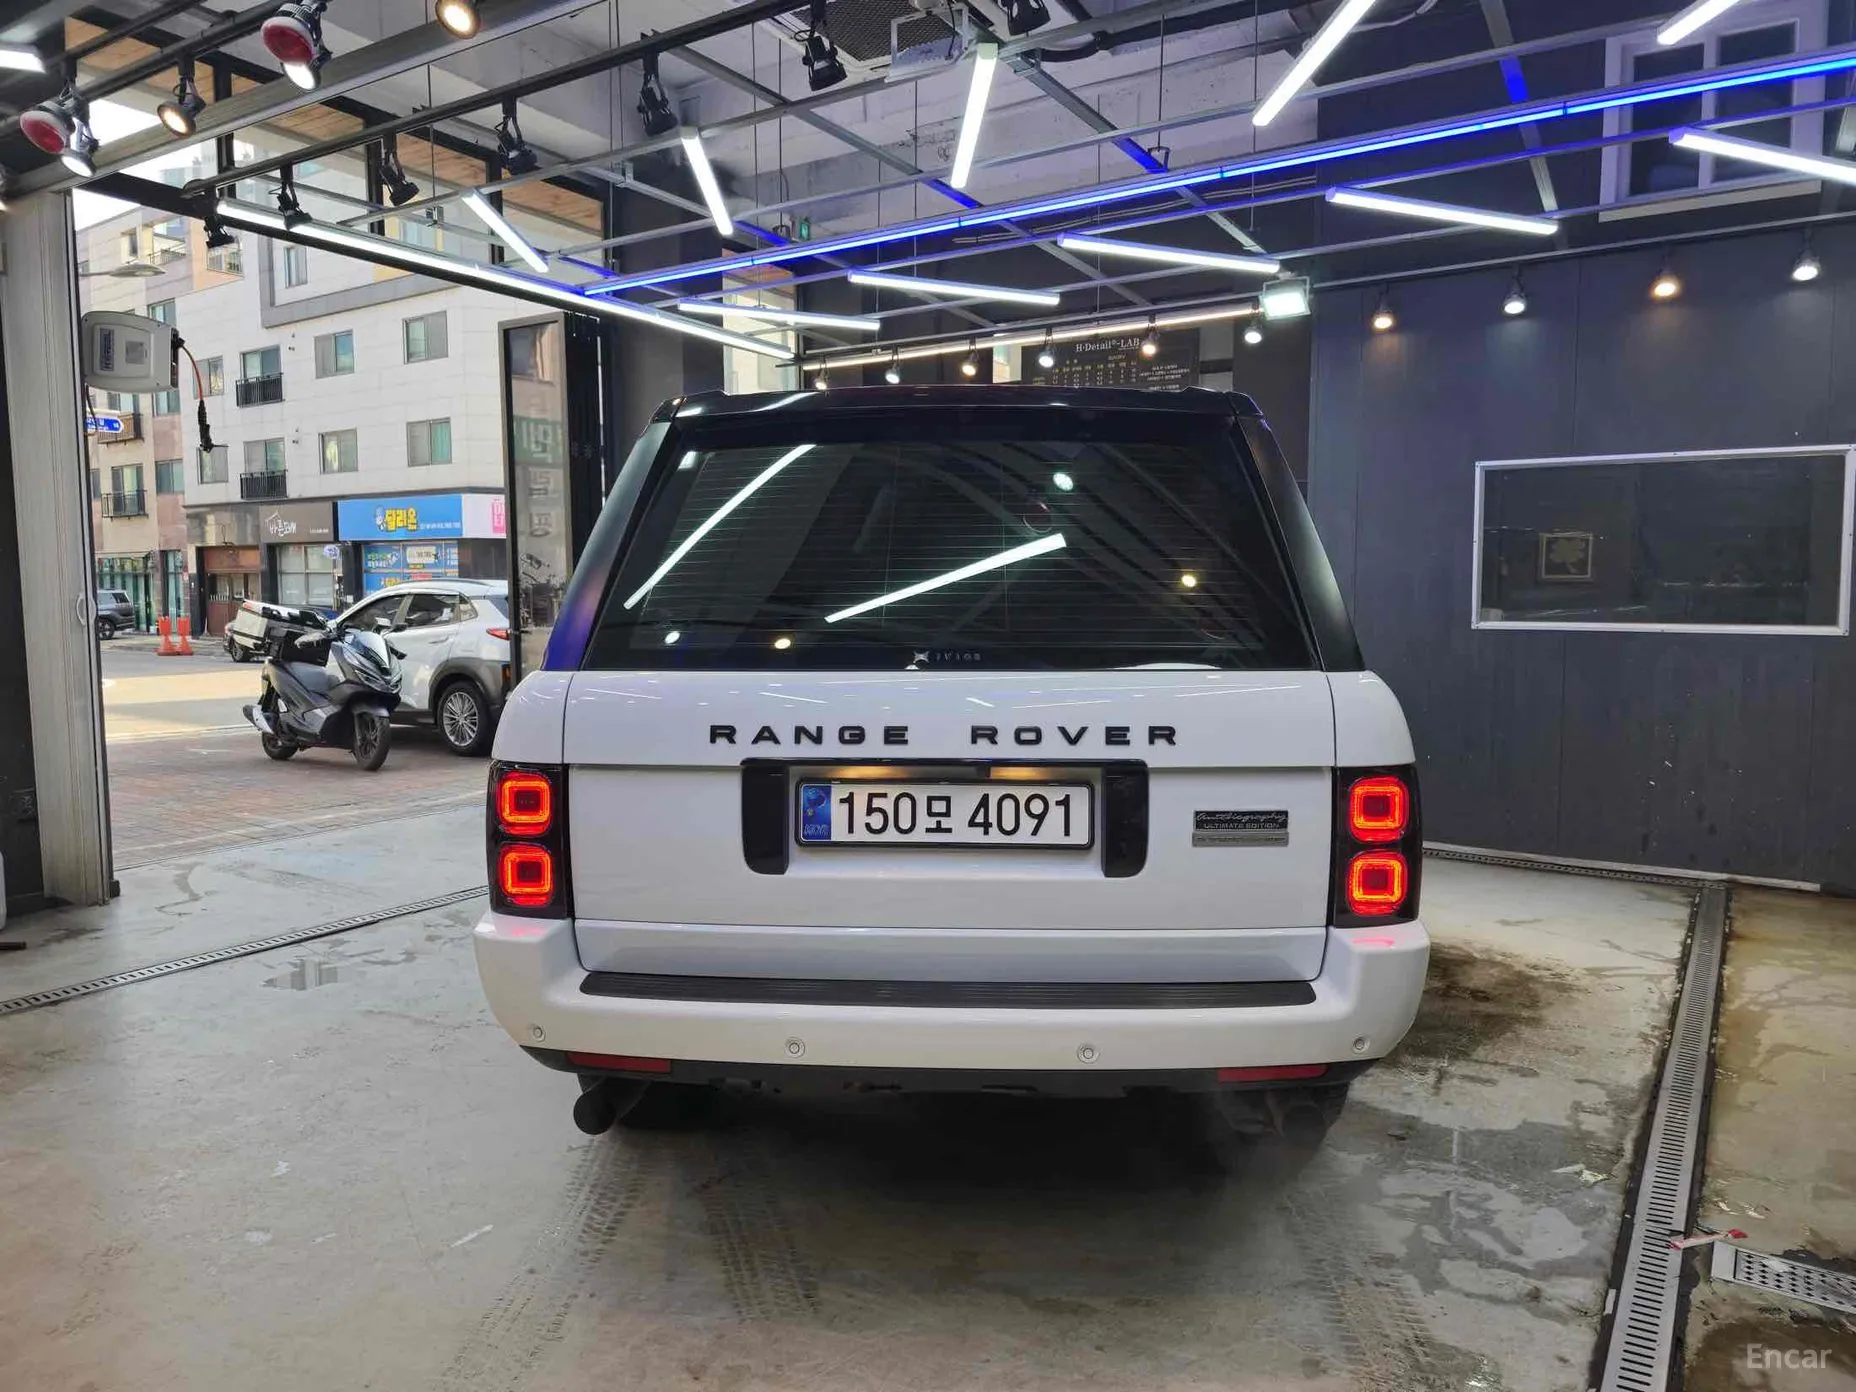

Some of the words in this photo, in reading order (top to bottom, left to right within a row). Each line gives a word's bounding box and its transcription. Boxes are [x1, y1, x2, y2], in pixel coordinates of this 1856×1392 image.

[709, 725, 909, 745] RANGE
[971, 726, 1177, 745] ROVER
[838, 791, 952, 836] 150모
[967, 793, 1072, 837] 4091
